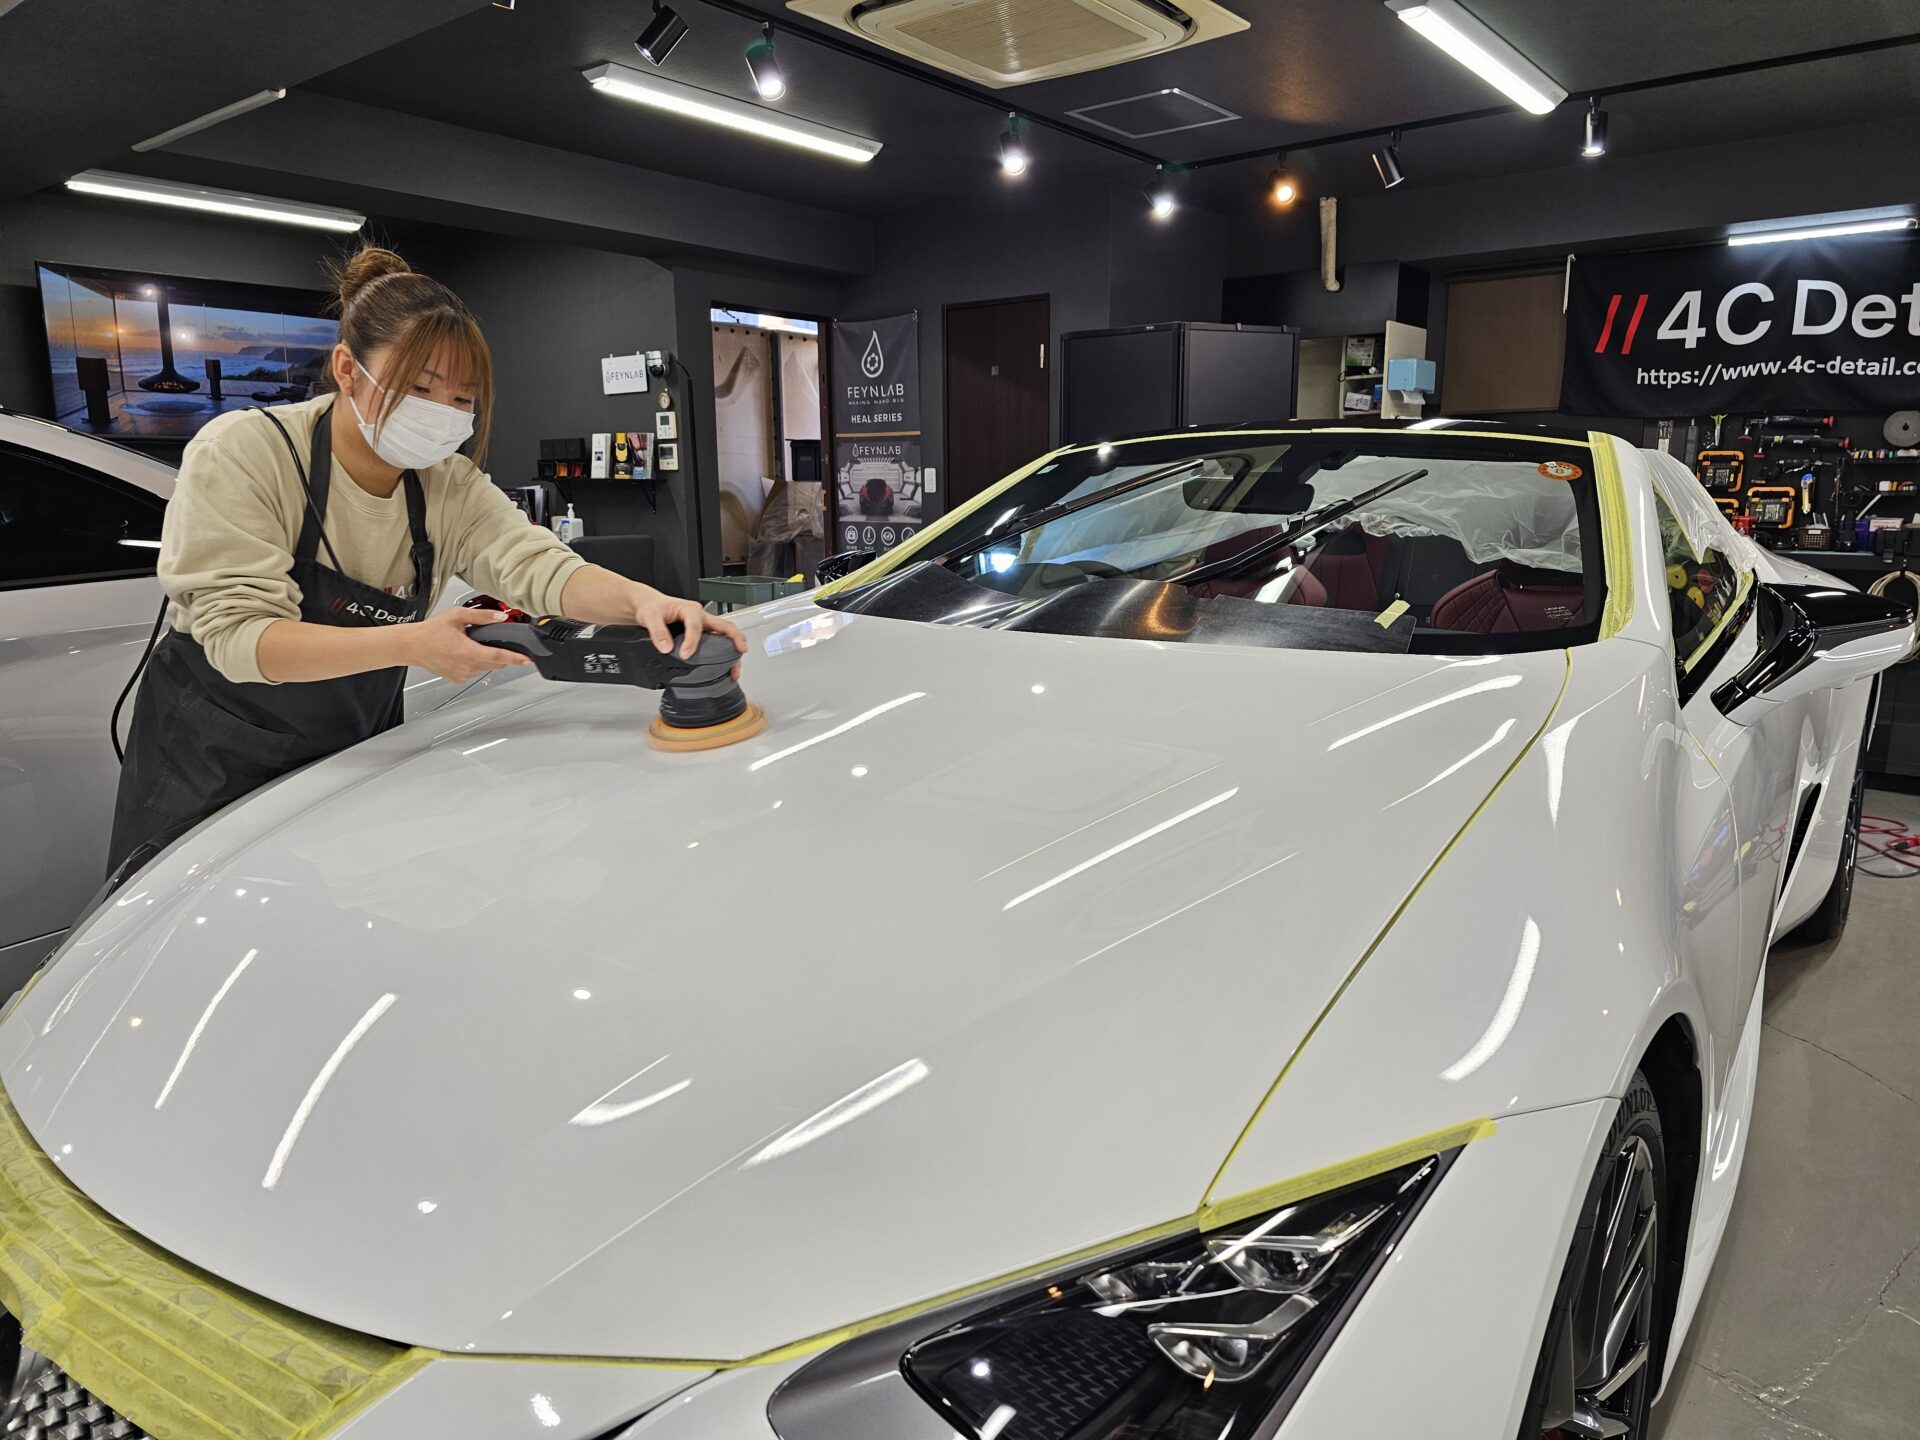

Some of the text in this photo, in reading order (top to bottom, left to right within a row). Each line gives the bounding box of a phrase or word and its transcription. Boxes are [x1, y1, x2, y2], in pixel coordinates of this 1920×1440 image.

[610, 370, 643, 381] FEYNLAB
[1636, 355, 1920, 389] https://www.4c-detail.c
[847, 384, 904, 398] FEYNLAB
[851, 412, 902, 423] HEAL SERIES
[859, 445, 901, 455] FEYNLAB
[1608, 1087, 1654, 1154] DUNLOP
